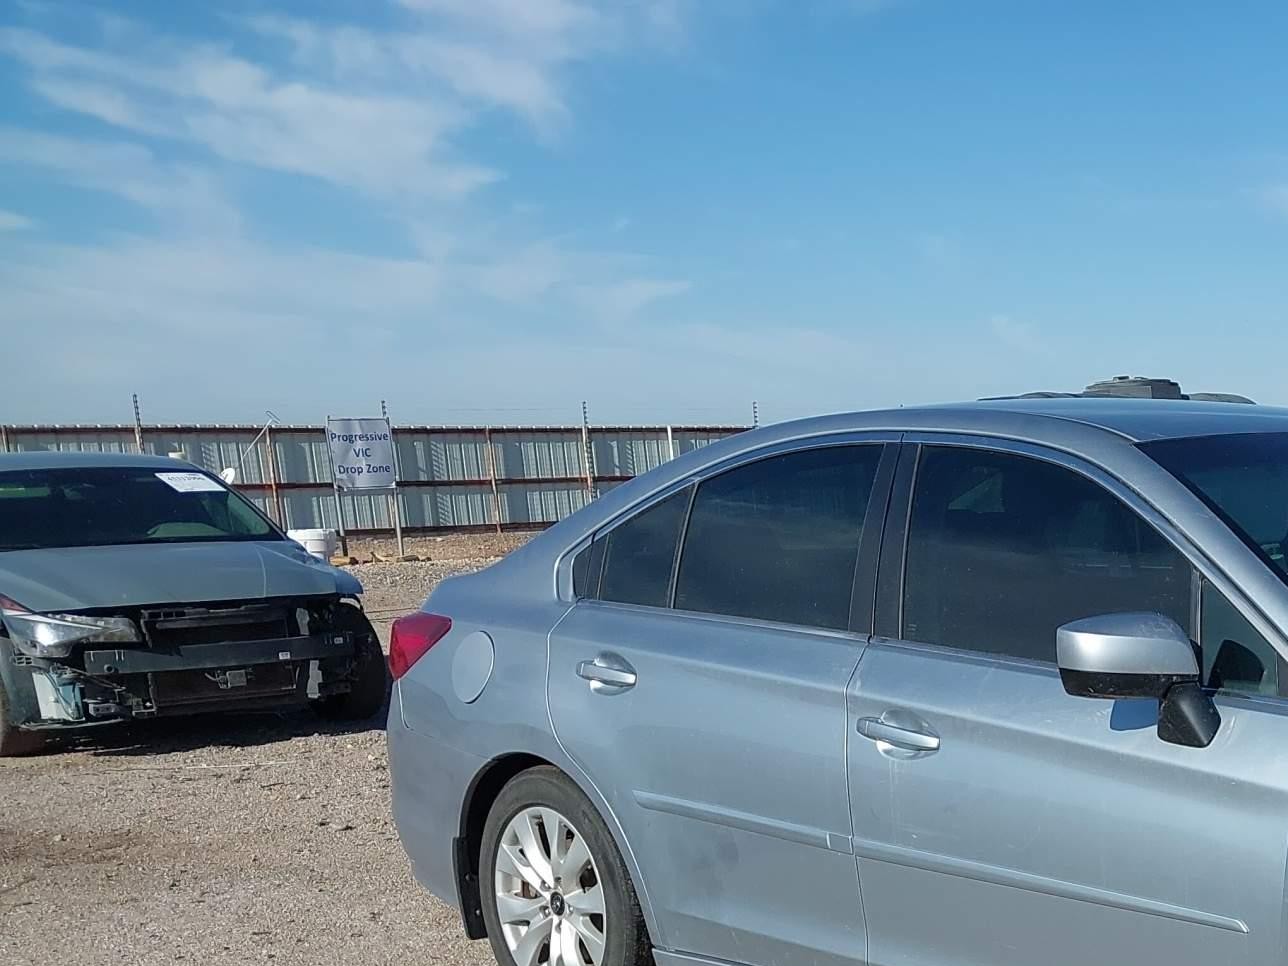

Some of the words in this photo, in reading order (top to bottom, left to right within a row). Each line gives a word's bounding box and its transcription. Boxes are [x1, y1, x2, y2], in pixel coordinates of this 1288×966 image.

[330, 432, 389, 444] Progressive
[353, 448, 372, 457] VIC
[338, 465, 363, 475] Drop
[366, 464, 390, 473] Zone
